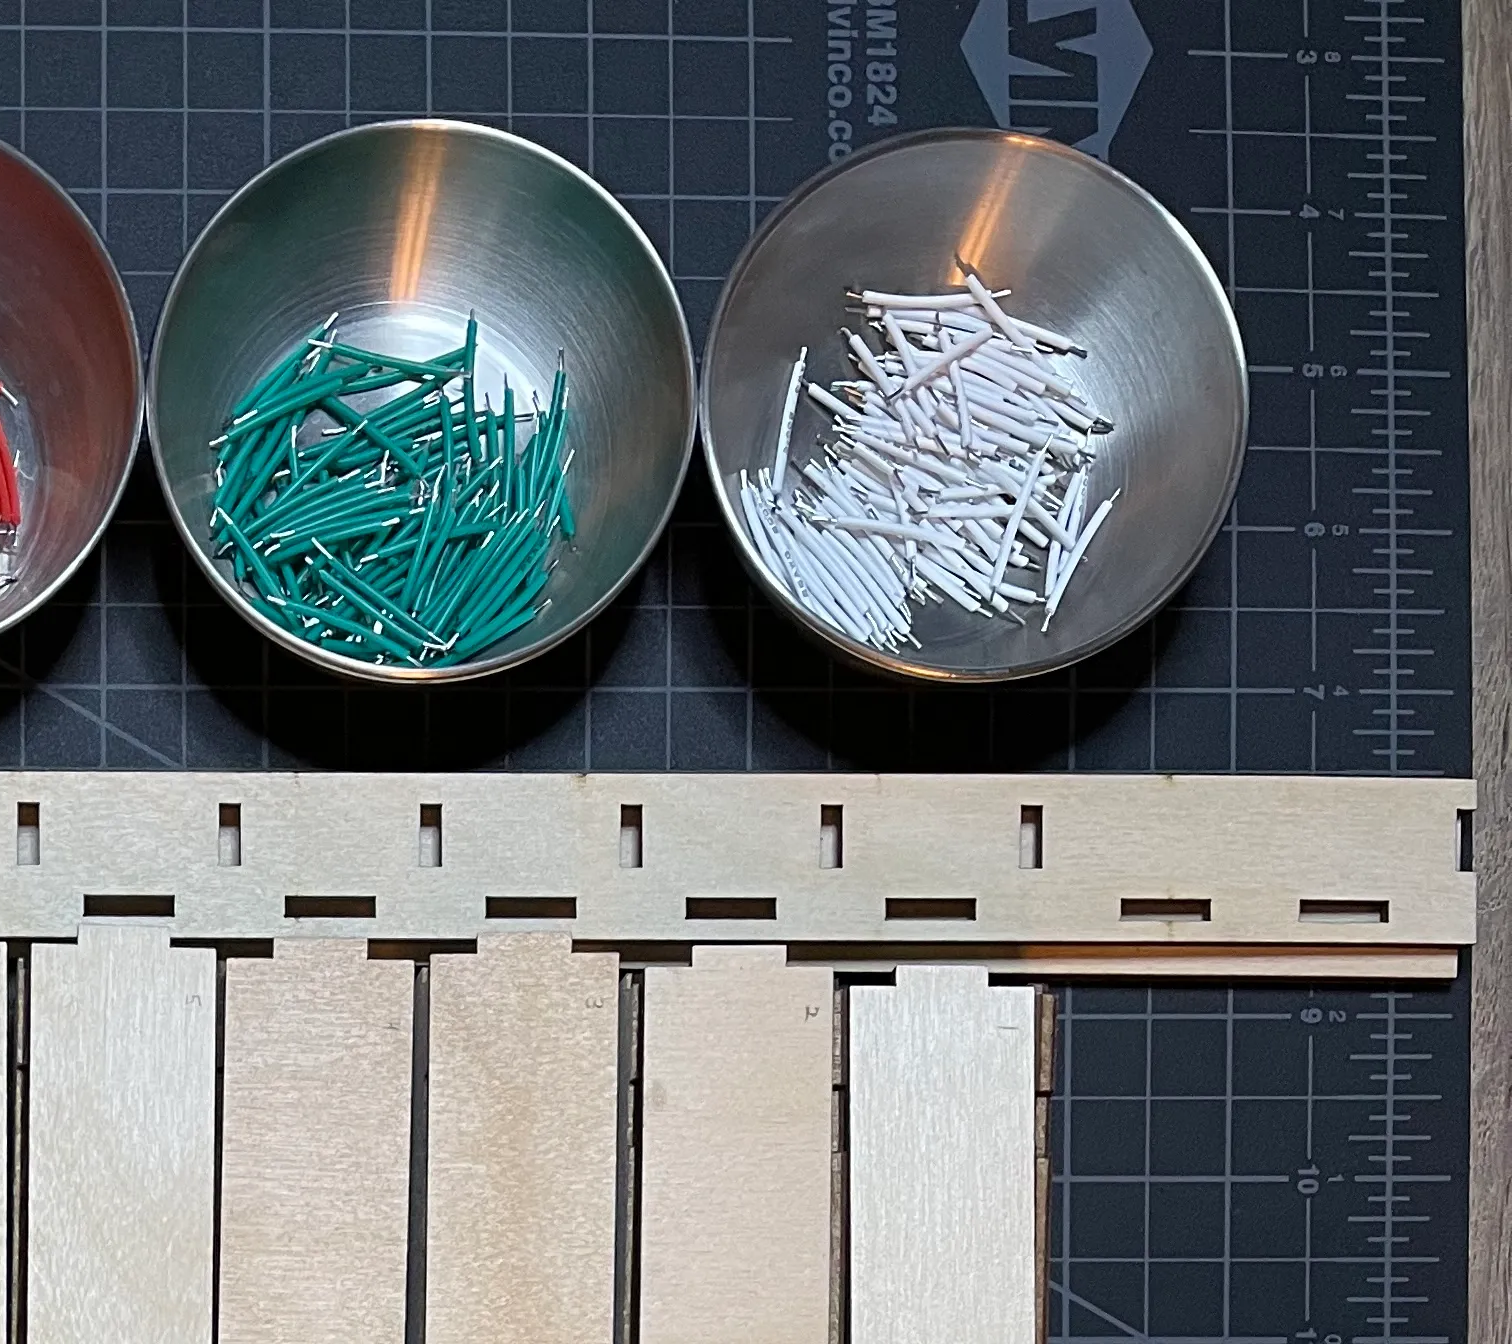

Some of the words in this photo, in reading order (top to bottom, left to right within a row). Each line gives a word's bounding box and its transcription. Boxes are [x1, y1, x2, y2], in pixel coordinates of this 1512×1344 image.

[1297, 50, 1317, 64] 3
[1299, 204, 1319, 218] 4
[1303, 363, 1323, 377] 5
[1305, 523, 1325, 536] 6
[1303, 684, 1324, 700] 7
[1301, 1008, 1322, 1023] 9
[1297, 1164, 1319, 1193] 10
